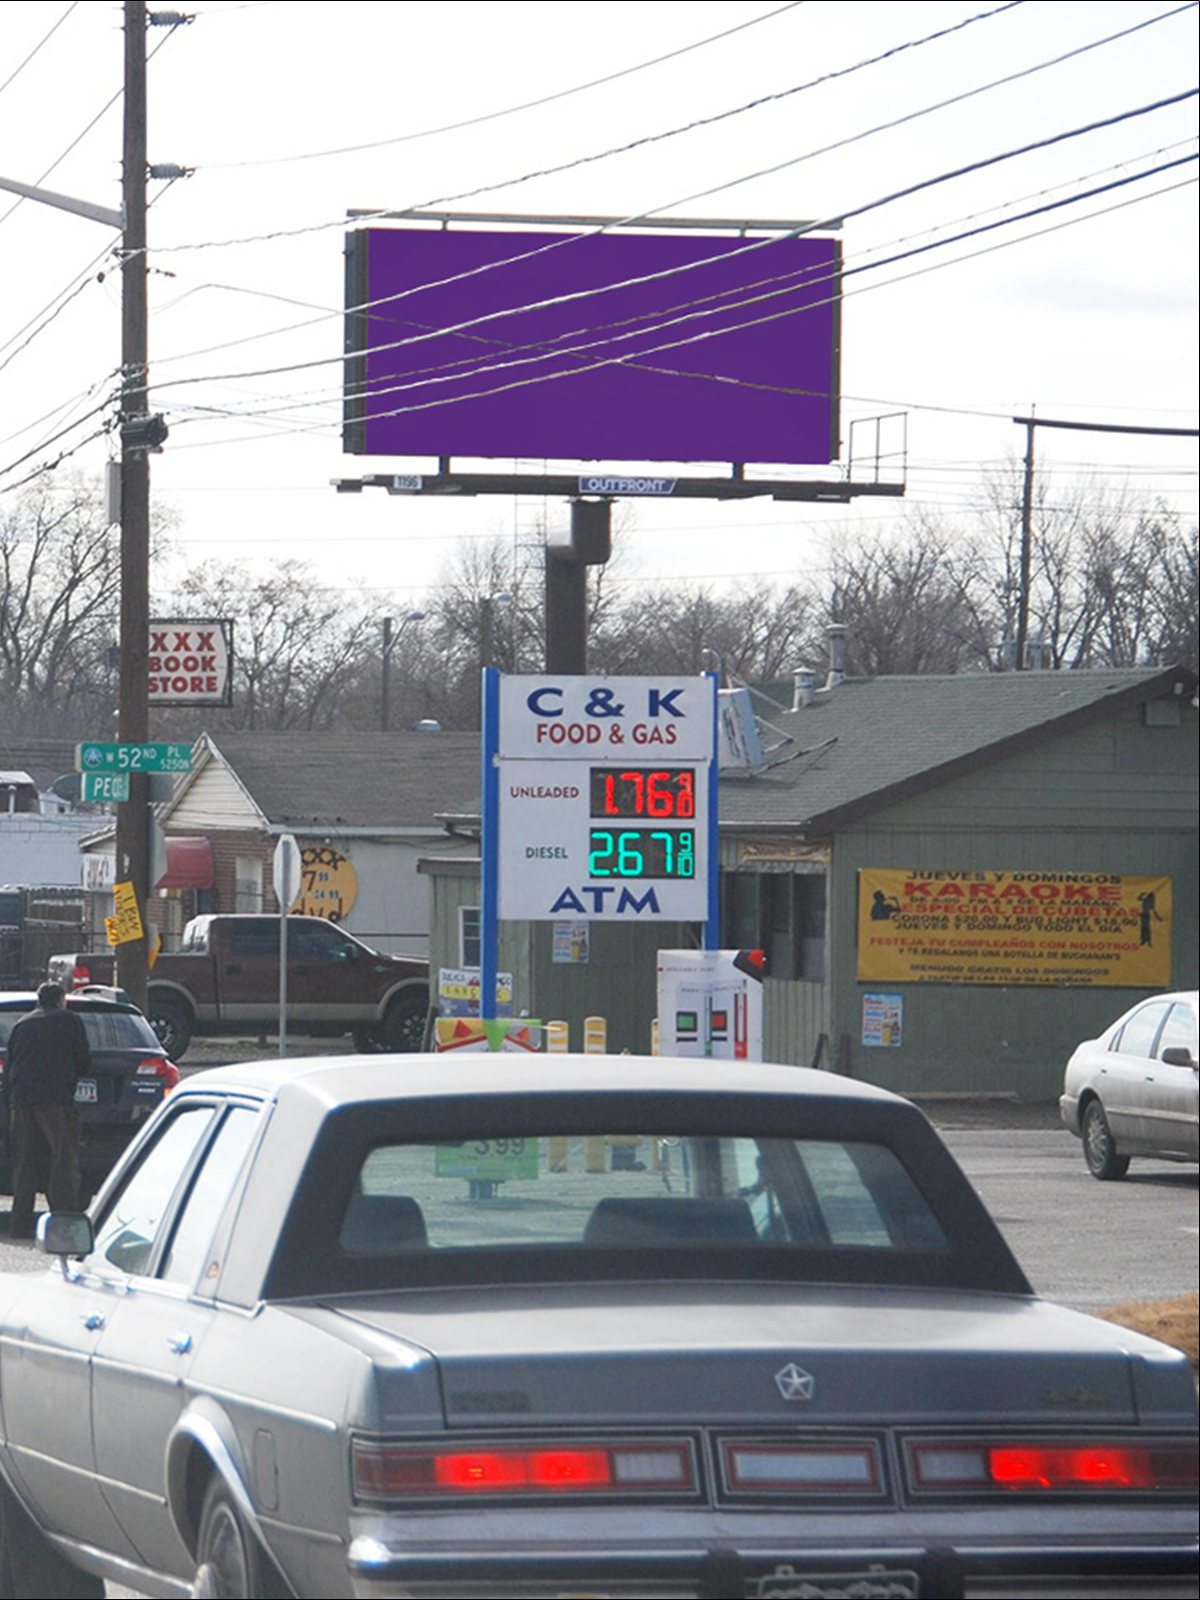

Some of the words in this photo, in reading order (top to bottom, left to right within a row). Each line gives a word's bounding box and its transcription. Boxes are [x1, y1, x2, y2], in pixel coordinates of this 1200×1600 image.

[588, 478, 667, 491] OUTFRONT
[150, 632, 216, 651] XXX
[149, 656, 217, 673] BOOK
[149, 676, 218, 693] STORE
[527, 687, 564, 718] C
[584, 687, 625, 718] &
[648, 688, 686, 718] K
[536, 723, 601, 744] FOOD
[609, 724, 625, 744] &
[632, 724, 677, 744] GAS
[167, 746, 180, 757] PL
[510, 786, 580, 798] UNLEADED
[525, 846, 569, 859] DIESEL
[907, 871, 987, 881] JUEVES
[994, 872, 1005, 882] Y
[1013, 873, 1122, 884] DOMINGOS
[904, 882, 1123, 901] KARAOKE
[549, 887, 661, 913] ATM
[901, 904, 1006, 915] ESPECIAL
[1012, 905, 1039, 915] DE
[1043, 906, 1142, 918] CUBETAS
[891, 914, 950, 922] CORONA
[1003, 915, 1012, 923] Y
[1016, 916, 1044, 924] BUD
[1048, 916, 1090, 925] LIGHT
[895, 922, 949, 930] JUEVES
[966, 923, 1032, 932] DOMINGO
[1037, 924, 1074, 932] TODO
[869, 938, 925, 946] FESTEJA
[928, 938, 946, 946] TU
[949, 937, 1036, 949] CUMPLEAÑOS
[1039, 940, 1066, 949] CON
[1070, 941, 1140, 950] NOSOTROS
[981, 949, 1001, 957] UNA
[1003, 950, 1045, 958] BOTELLA
[1047, 951, 1059, 959] DE
[909, 963, 964, 973] MENUDO
[967, 966, 1013, 974] GRATIS
[1015, 967, 1040, 975] LOS
[1043, 967, 1110, 975] DOMINGOS
